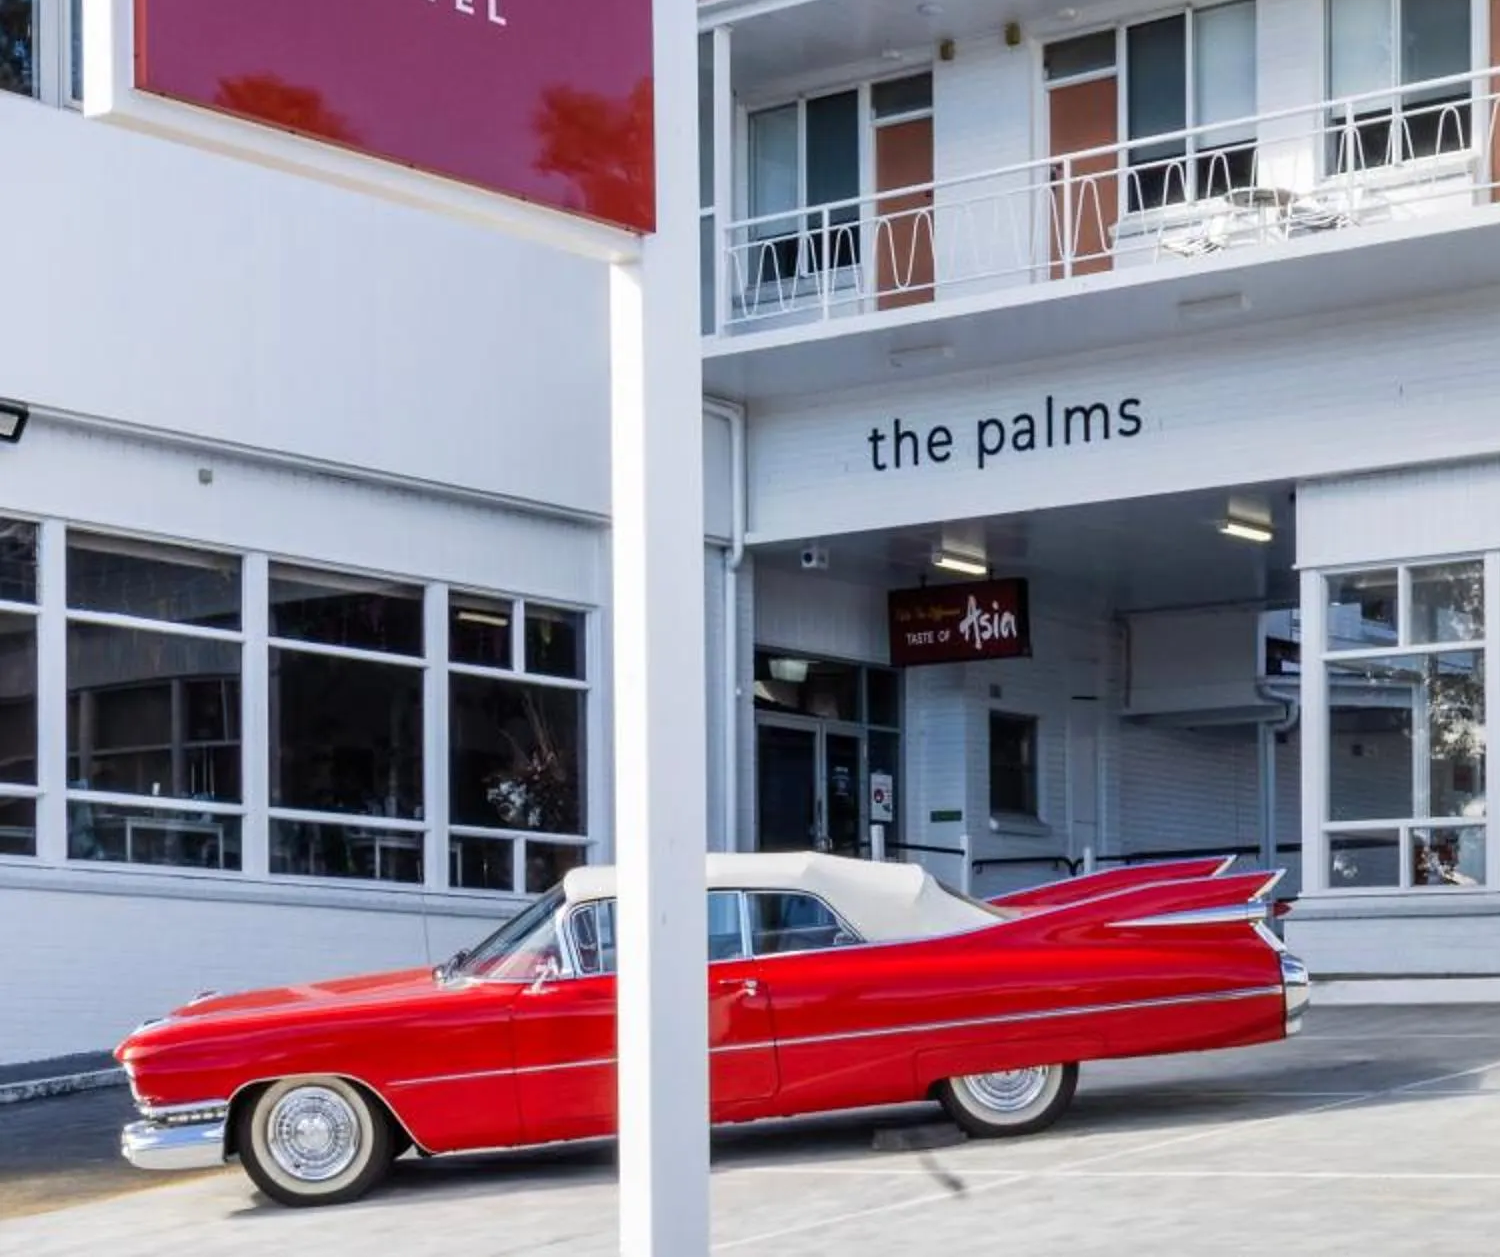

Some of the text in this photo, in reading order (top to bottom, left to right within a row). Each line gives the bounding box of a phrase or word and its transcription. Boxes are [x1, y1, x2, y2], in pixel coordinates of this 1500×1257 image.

[867, 395, 1143, 472] the palms
[905, 630, 935, 645] TASTE
[937, 629, 951, 643] OF
[959, 594, 1017, 650] Asia
